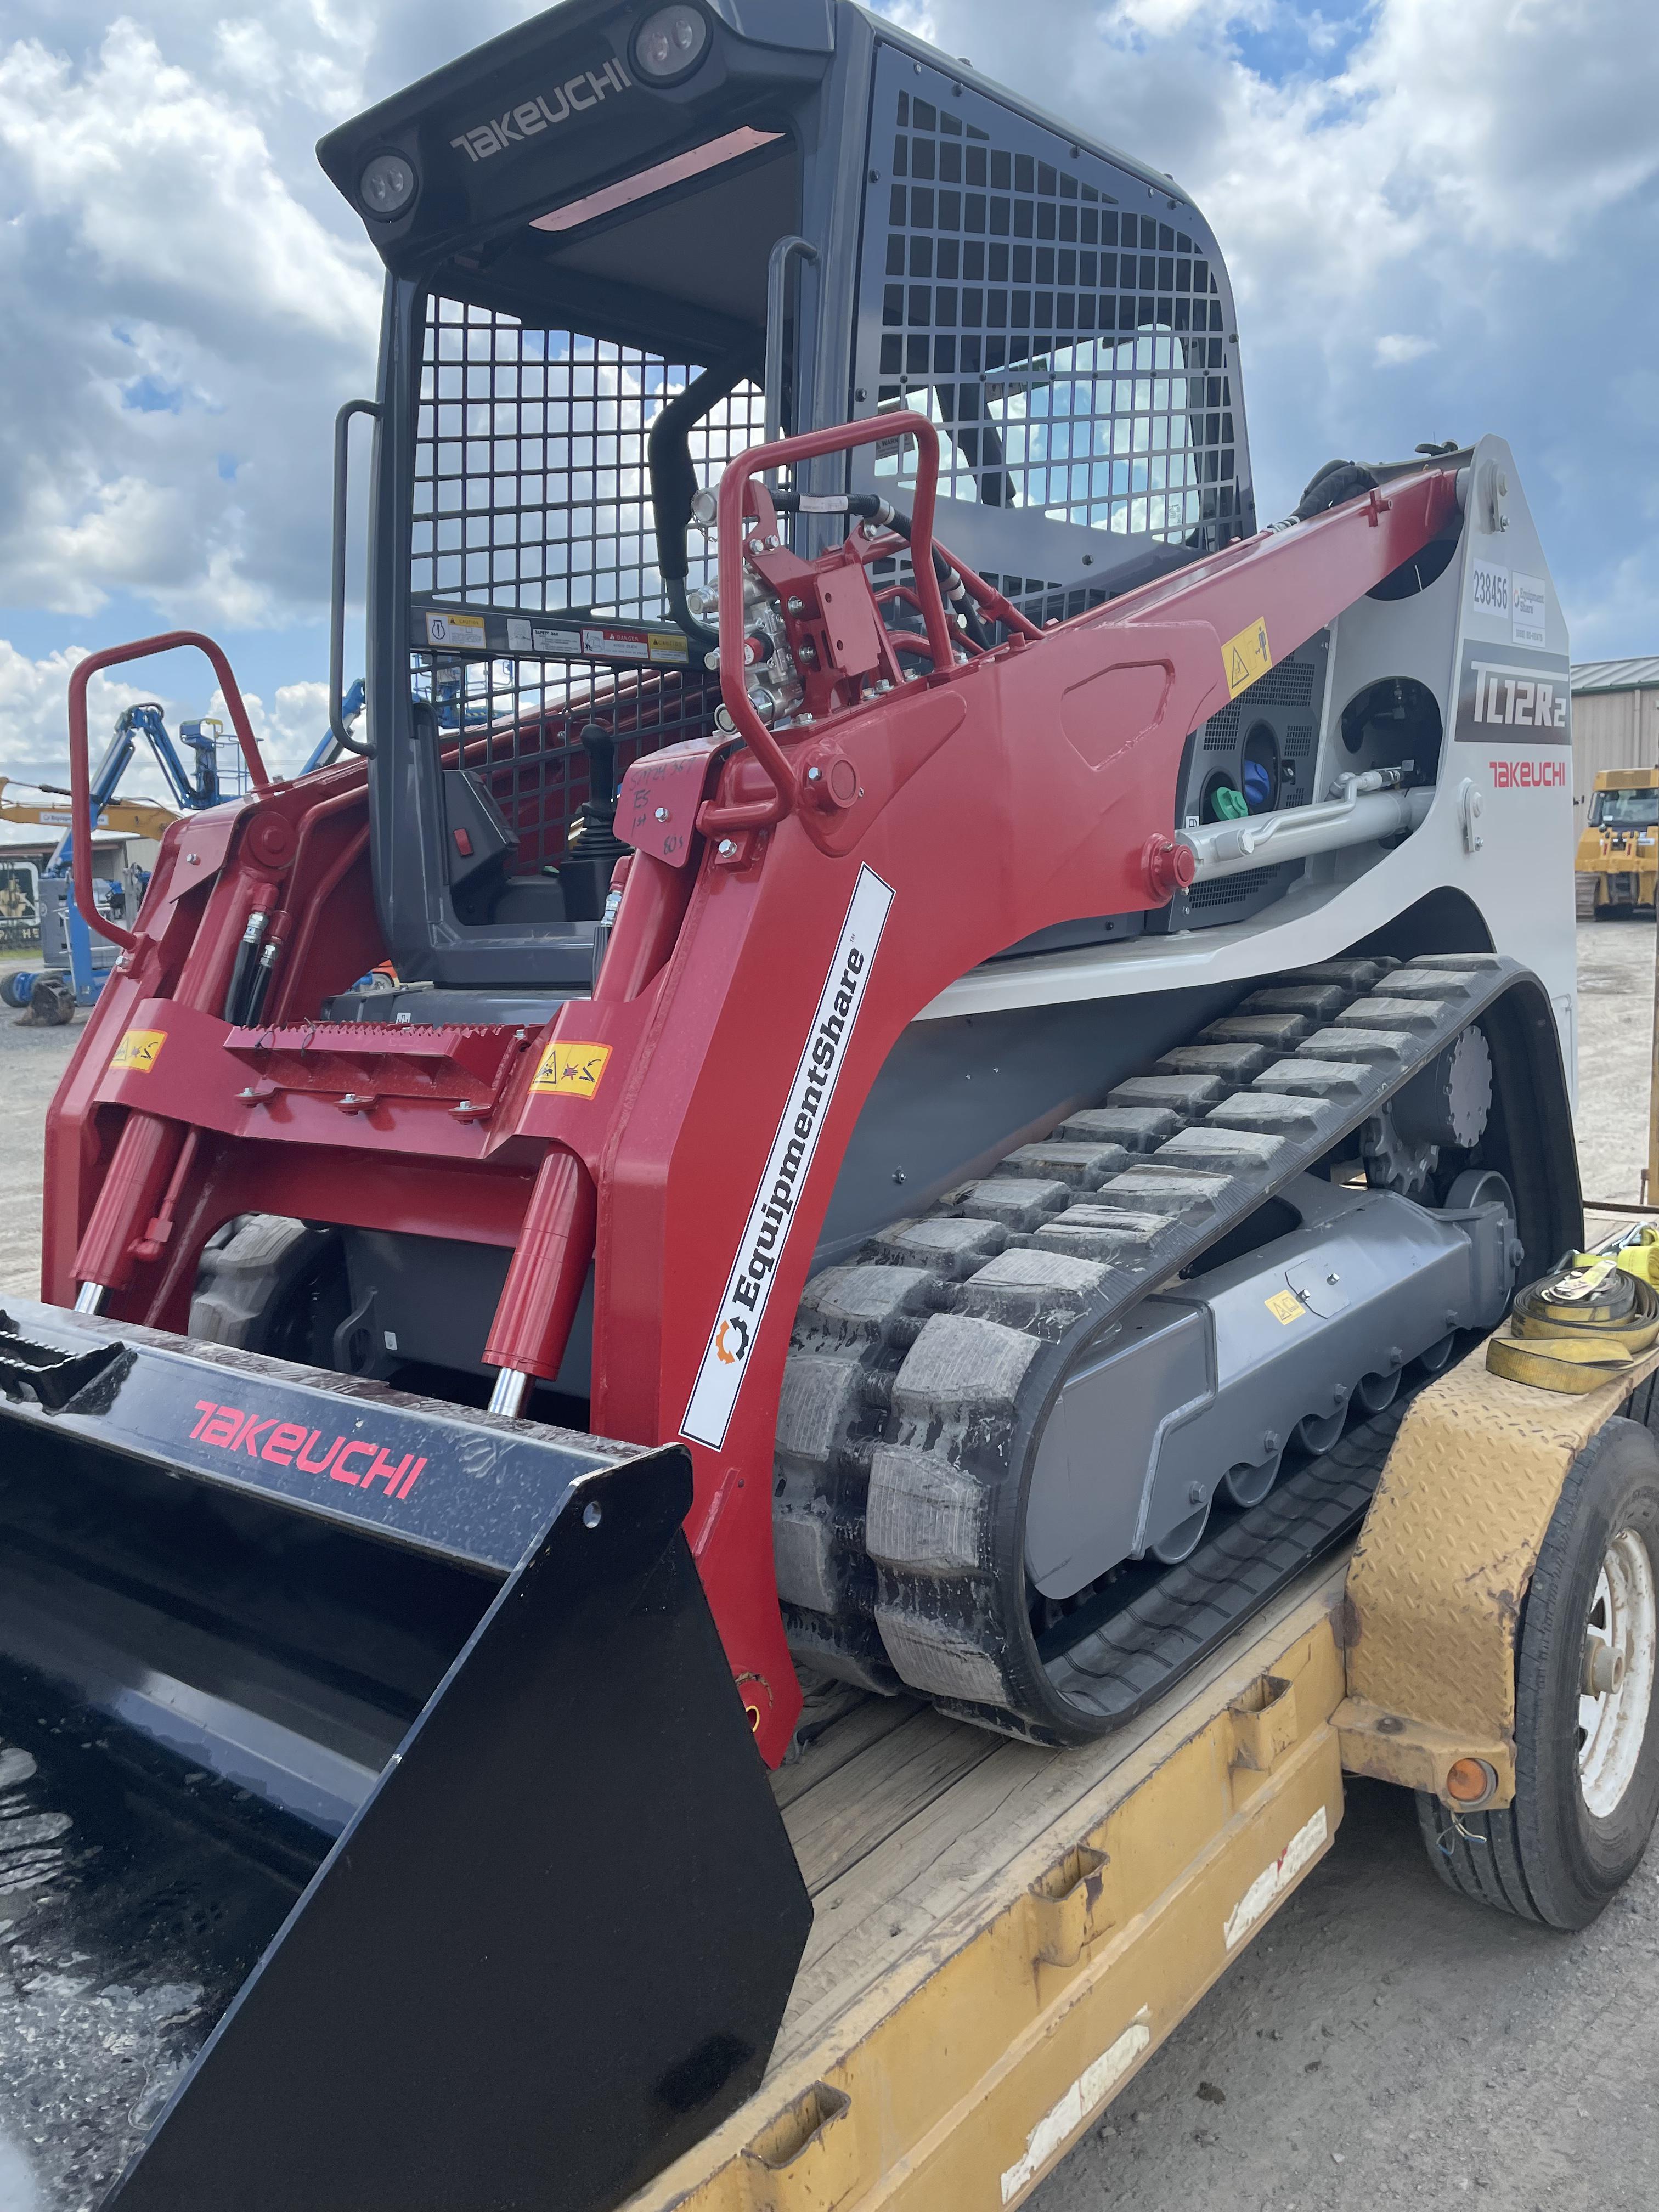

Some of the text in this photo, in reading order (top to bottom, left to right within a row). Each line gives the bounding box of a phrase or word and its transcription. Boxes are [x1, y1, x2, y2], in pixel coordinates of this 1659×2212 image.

[449, 57, 633, 163] TAKEUCHI
[1474, 569, 1508, 610] 238456
[1520, 588, 1544, 604] Equipment
[1520, 601, 1534, 614] Share
[1471, 660, 1569, 728] TL12R2
[1489, 761, 1566, 788] TAKEUCHI
[732, 947, 865, 1312] EquipmentShare
[189, 1399, 428, 1499] TAKEUCHI
